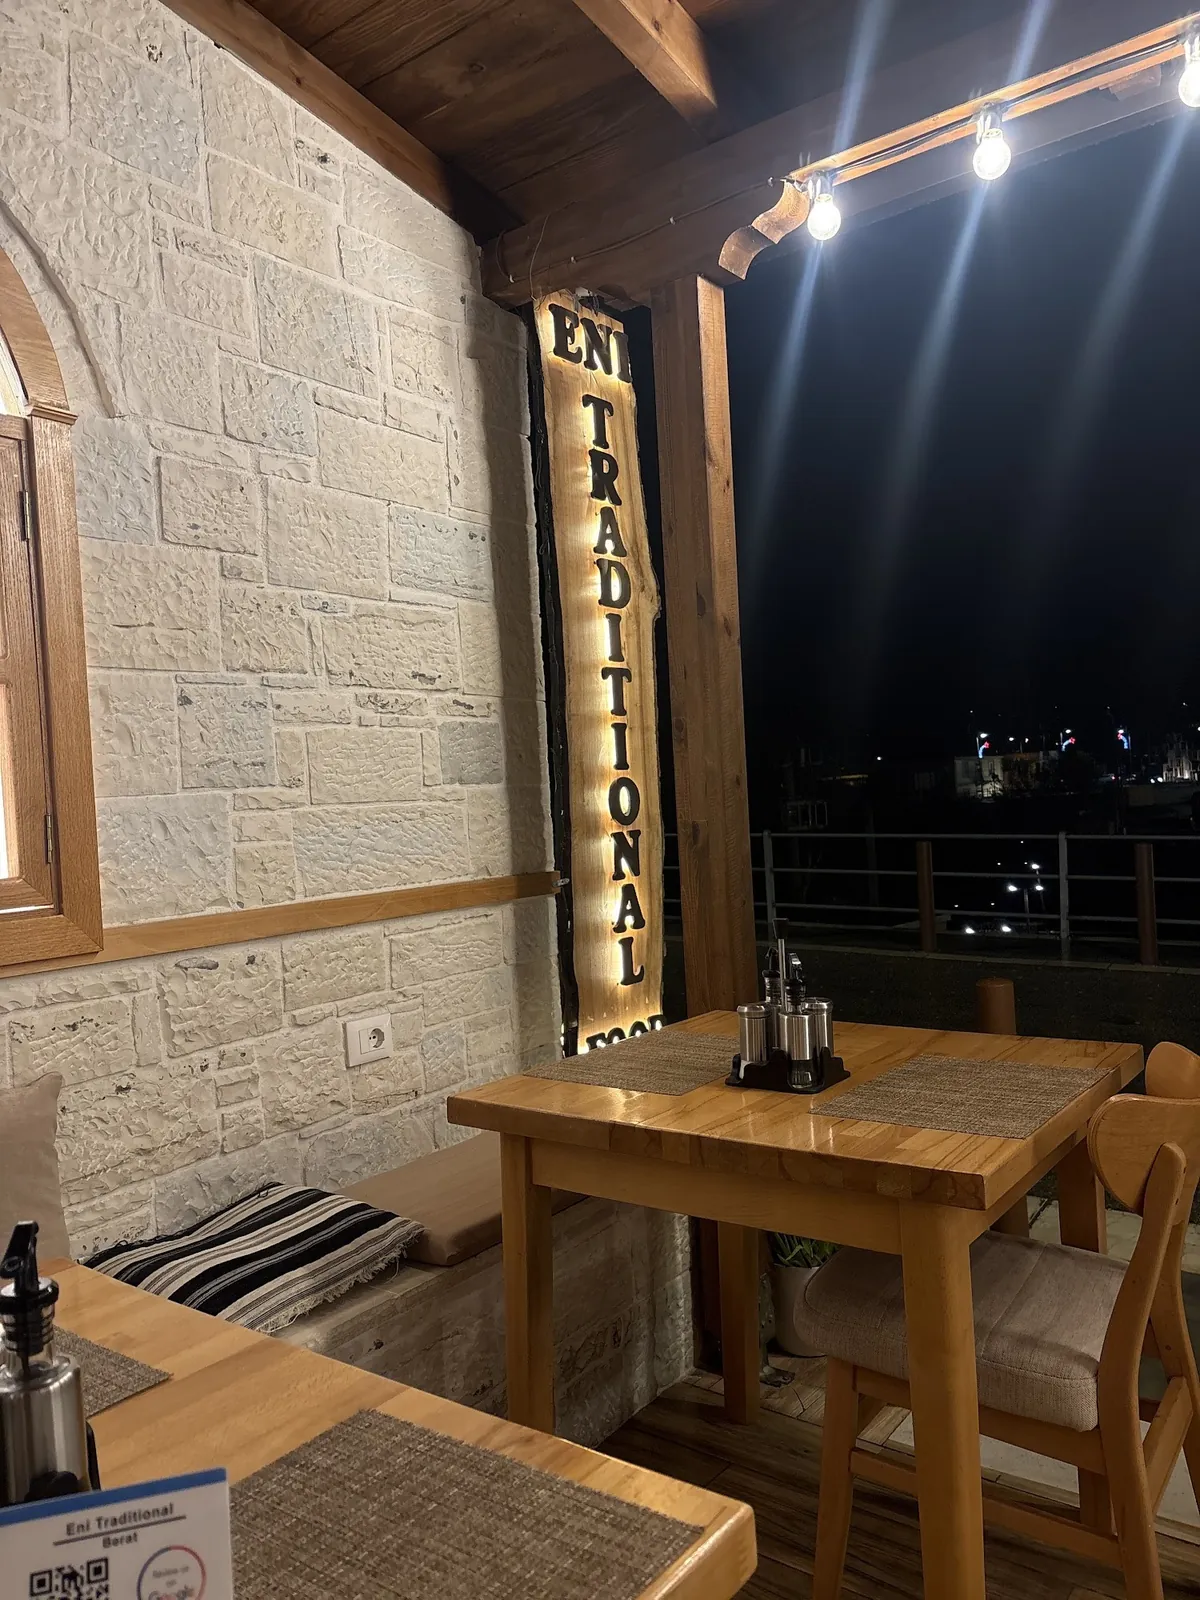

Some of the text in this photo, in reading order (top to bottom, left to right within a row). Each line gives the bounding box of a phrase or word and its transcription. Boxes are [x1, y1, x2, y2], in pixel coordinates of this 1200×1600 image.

[548, 303, 632, 384] ENI
[582, 394, 646, 986] TRADITIONAL
[66, 1502, 175, 1537] Eni Traditional
[102, 1532, 138, 1549] Berat
